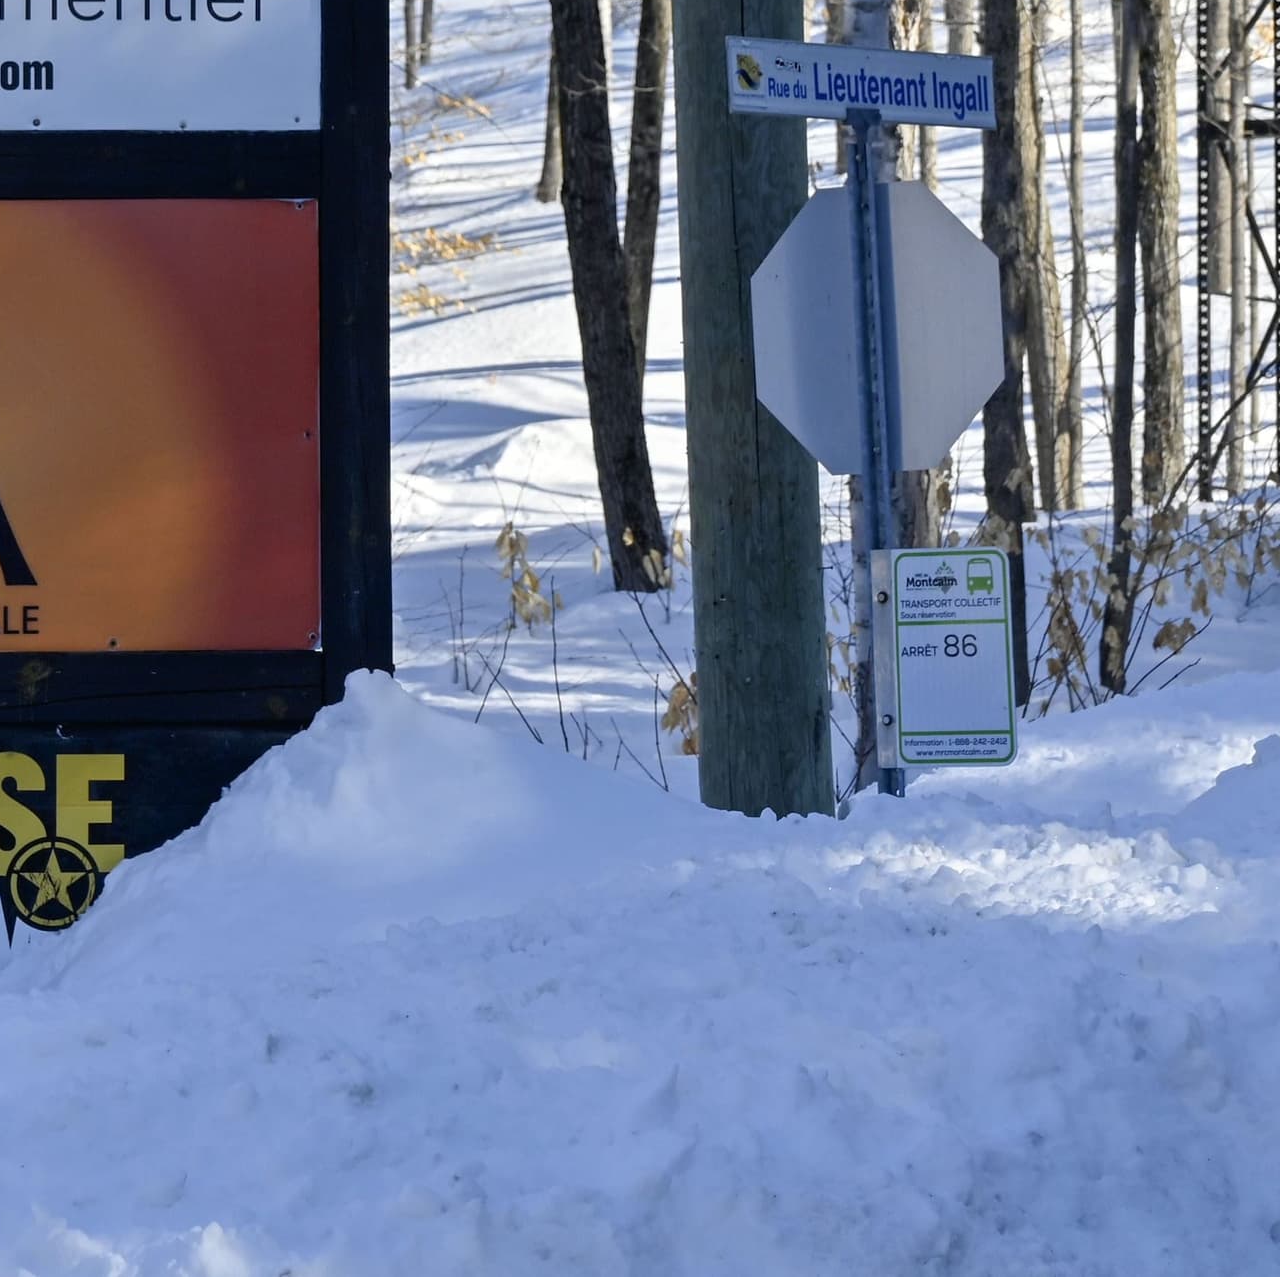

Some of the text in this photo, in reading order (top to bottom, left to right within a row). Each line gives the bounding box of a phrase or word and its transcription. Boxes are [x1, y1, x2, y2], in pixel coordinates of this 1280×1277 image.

[767, 77, 790, 99] Rue
[793, 78, 807, 99] du
[813, 62, 928, 109] Lieutenant
[932, 71, 989, 120] Ingall
[906, 576, 958, 588] Montcalm
[900, 597, 1001, 609] TRANSPORT COLLECTIF
[900, 611, 917, 619] Sous
[901, 634, 977, 657] ARRÊT 86
